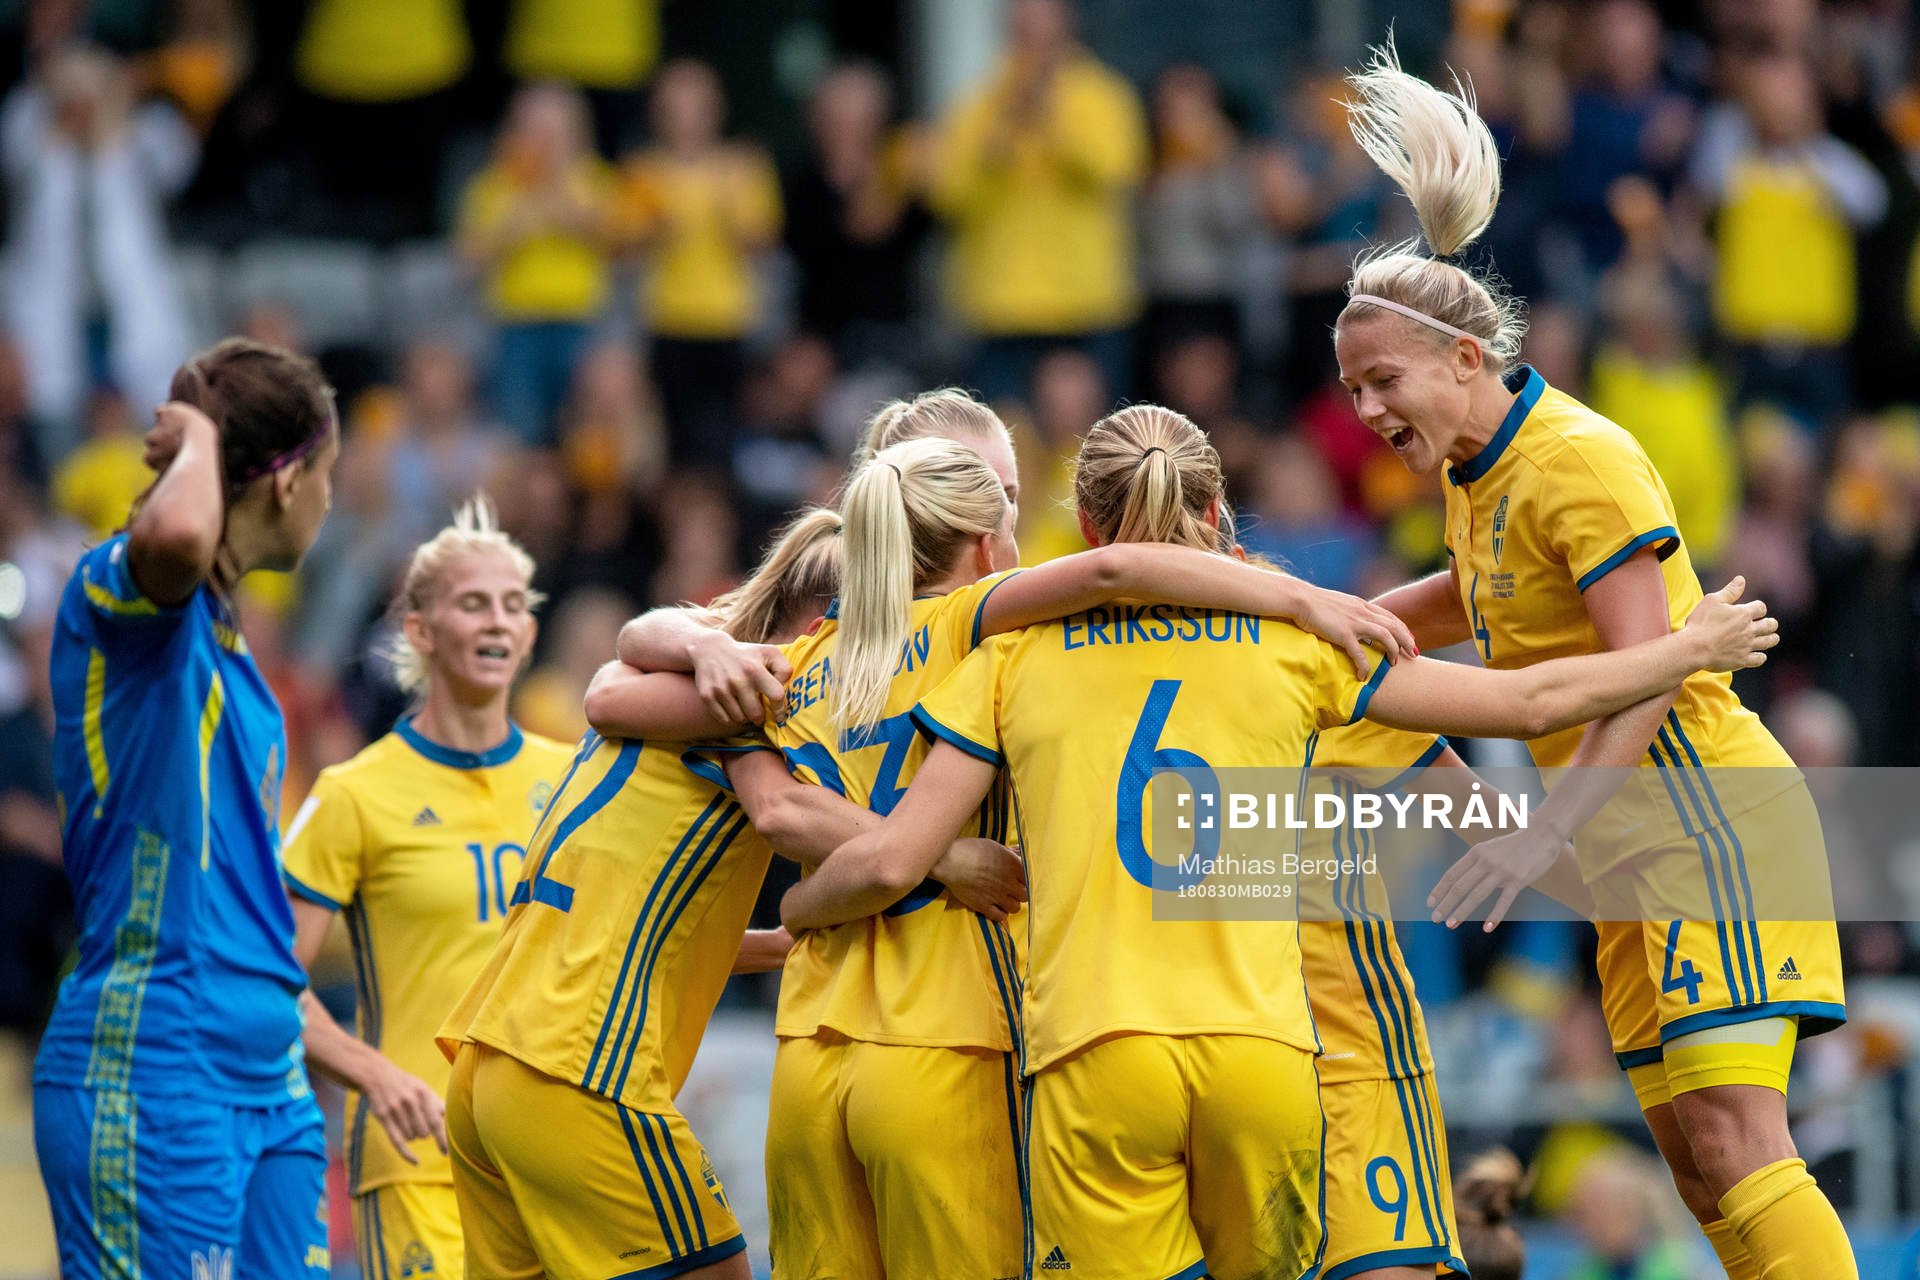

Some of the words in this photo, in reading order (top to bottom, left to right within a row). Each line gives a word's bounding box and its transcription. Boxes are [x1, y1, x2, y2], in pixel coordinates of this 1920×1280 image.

[1062, 603, 1261, 651] ERIKSSON
[1116, 679, 1222, 893] 6
[465, 842, 527, 922] 10
[1662, 917, 1704, 1005] 4
[1776, 971, 1802, 981] adidas
[1365, 1155, 1408, 1242] 9
[1041, 1261, 1072, 1271] adidas
